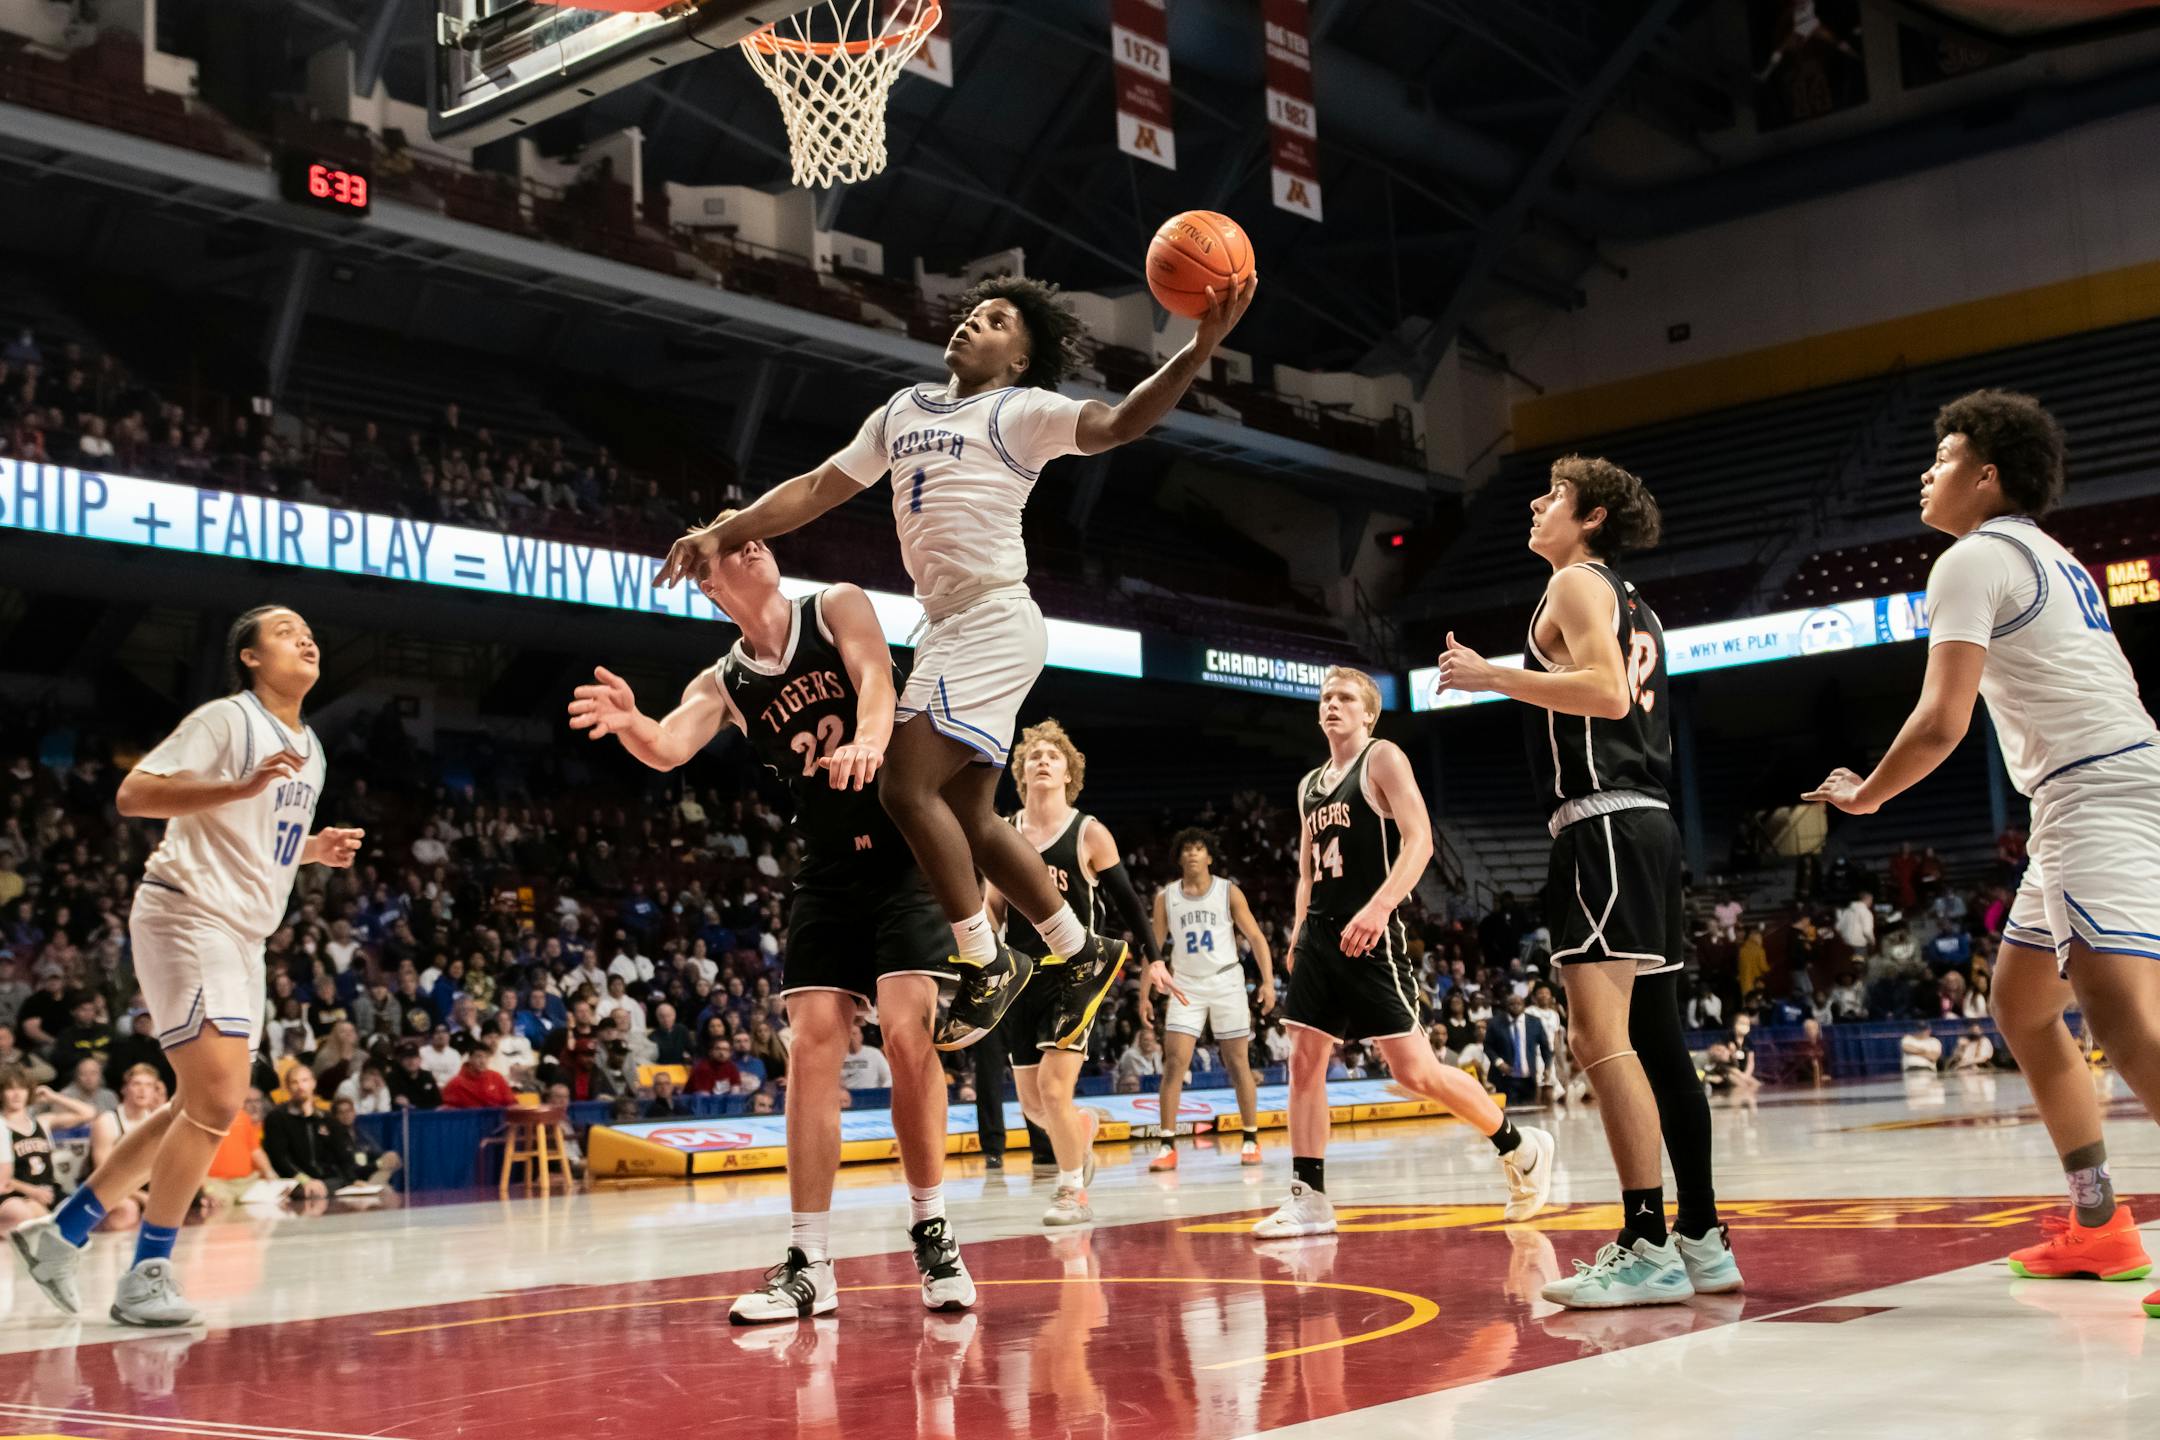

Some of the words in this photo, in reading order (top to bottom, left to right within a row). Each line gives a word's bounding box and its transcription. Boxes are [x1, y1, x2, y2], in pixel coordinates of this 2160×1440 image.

[1123, 36, 1161, 72] 1972
[309, 164, 367, 208] 6:33
[891, 429, 964, 463] NORTH
[910, 467, 926, 513] 1
[0, 460, 109, 537] HIP
[196, 487, 305, 566] FAIR
[328, 506, 436, 582] PLAY
[502, 534, 594, 605] WHY
[610, 551, 669, 614] WE
[2106, 560, 2150, 586] MAC
[2109, 579, 2160, 607] MPLS
[2055, 560, 2112, 632] 12
[1690, 639, 1717, 659] WHY
[1724, 636, 1741, 653] WE
[1748, 633, 1778, 651] PLAY
[761, 670, 845, 733] TIGERS
[791, 714, 844, 777] 22
[1307, 801, 1351, 841] TIGERS
[274, 820, 303, 866] 50
[854, 834, 873, 851] M
[1312, 836, 1343, 882] 14
[1180, 910, 1216, 929] NORTH
[1185, 930, 1214, 954] 24
